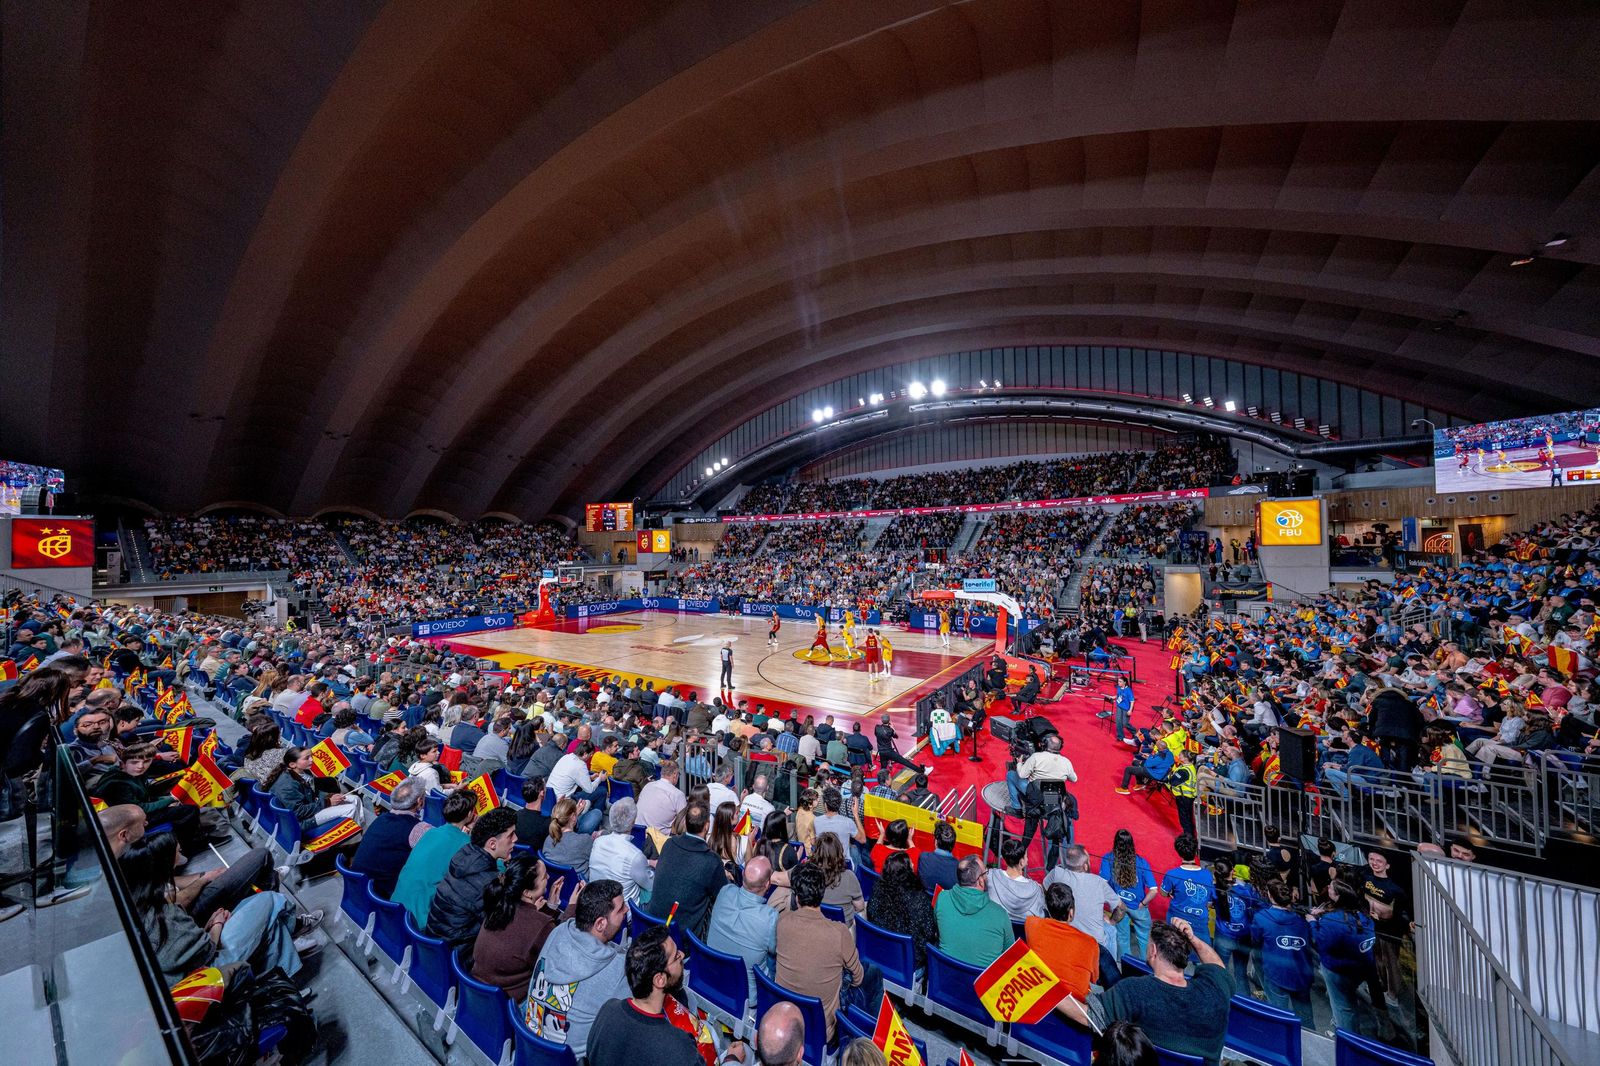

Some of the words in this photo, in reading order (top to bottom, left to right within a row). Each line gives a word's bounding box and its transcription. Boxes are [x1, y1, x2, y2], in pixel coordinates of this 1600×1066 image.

[1279, 528, 1302, 536] FBU
[590, 601, 618, 612] OVIEDO
[645, 600, 659, 608] OVD
[686, 600, 708, 608] OVIEDO
[798, 609, 812, 618] OVD
[432, 620, 465, 630] OVIEDO
[486, 618, 506, 626] OVD
[995, 966, 1052, 1022] ESPAÑA
